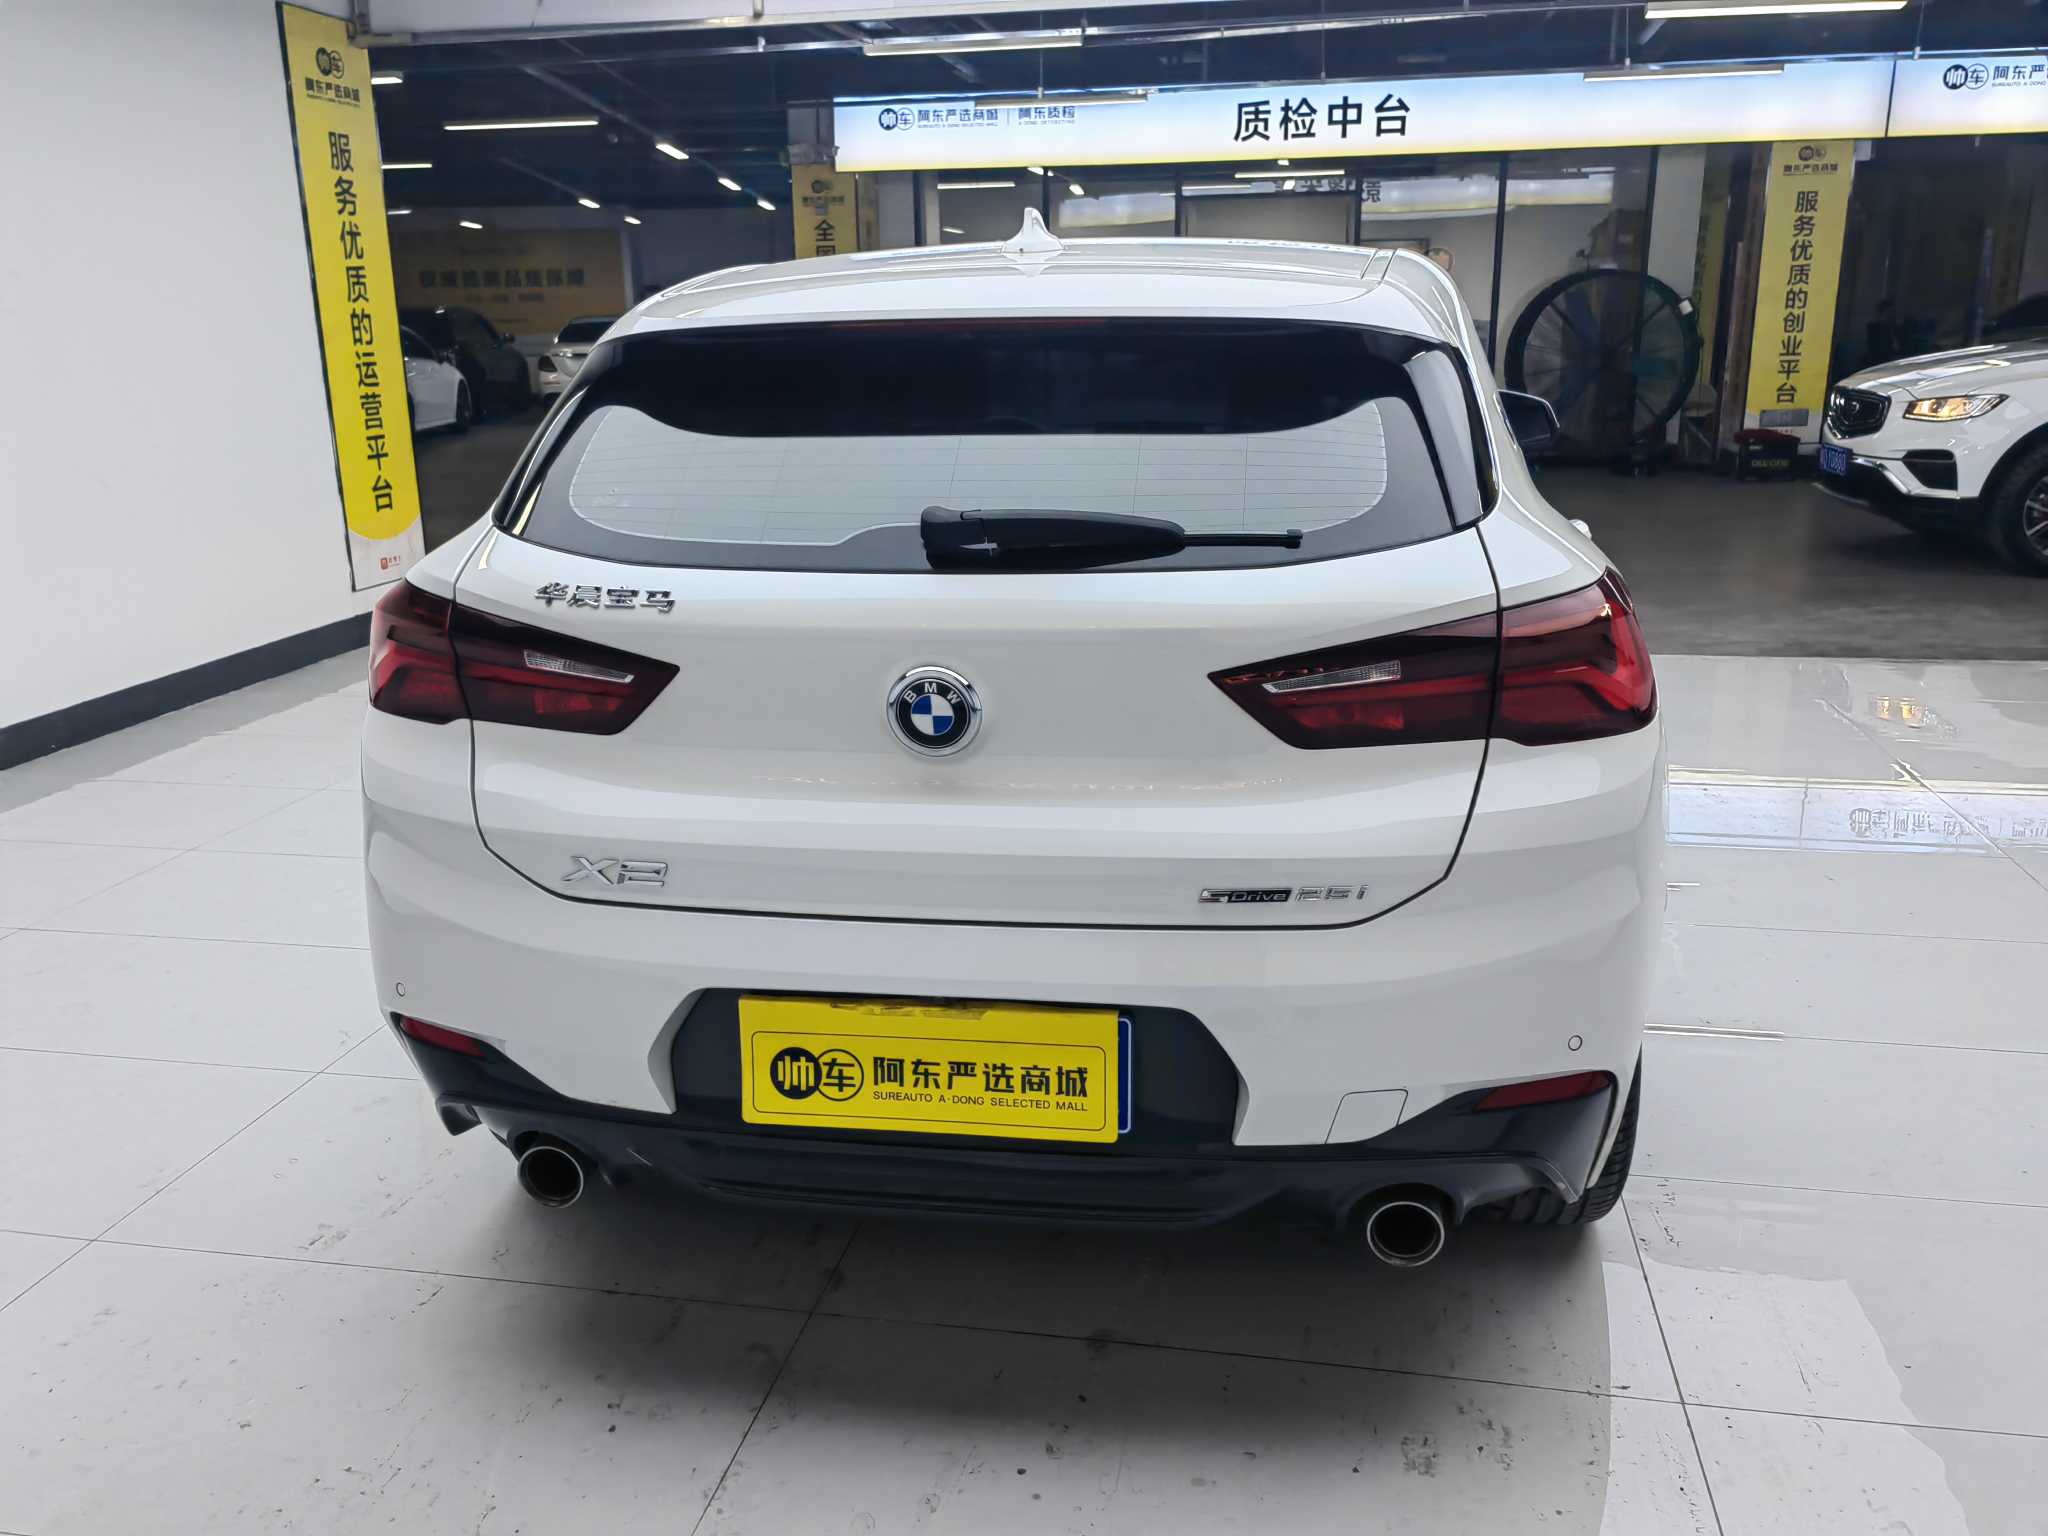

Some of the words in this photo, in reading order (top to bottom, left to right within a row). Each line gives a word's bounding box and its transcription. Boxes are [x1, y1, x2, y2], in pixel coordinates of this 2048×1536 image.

[1944, 64, 1988, 89] 帅车
[1993, 64, 2048, 81] 阿东严
[1233, 93, 1411, 142] 质检中台
[1775, 190, 1819, 404] 服务优质的创业平台
[328, 131, 394, 513] 服务优质的运营平台
[534, 582, 676, 614] 华晨宝马
[903, 682, 961, 705] BMW
[560, 855, 670, 887] X2
[772, 1049, 863, 1099] 帅车
[872, 1056, 1088, 1097] 阿东严选商城
[872, 1090, 933, 1103] SUREAUTO
[990, 1097, 1051, 1110] SELECTED
[1055, 1101, 1088, 1112] MALL
